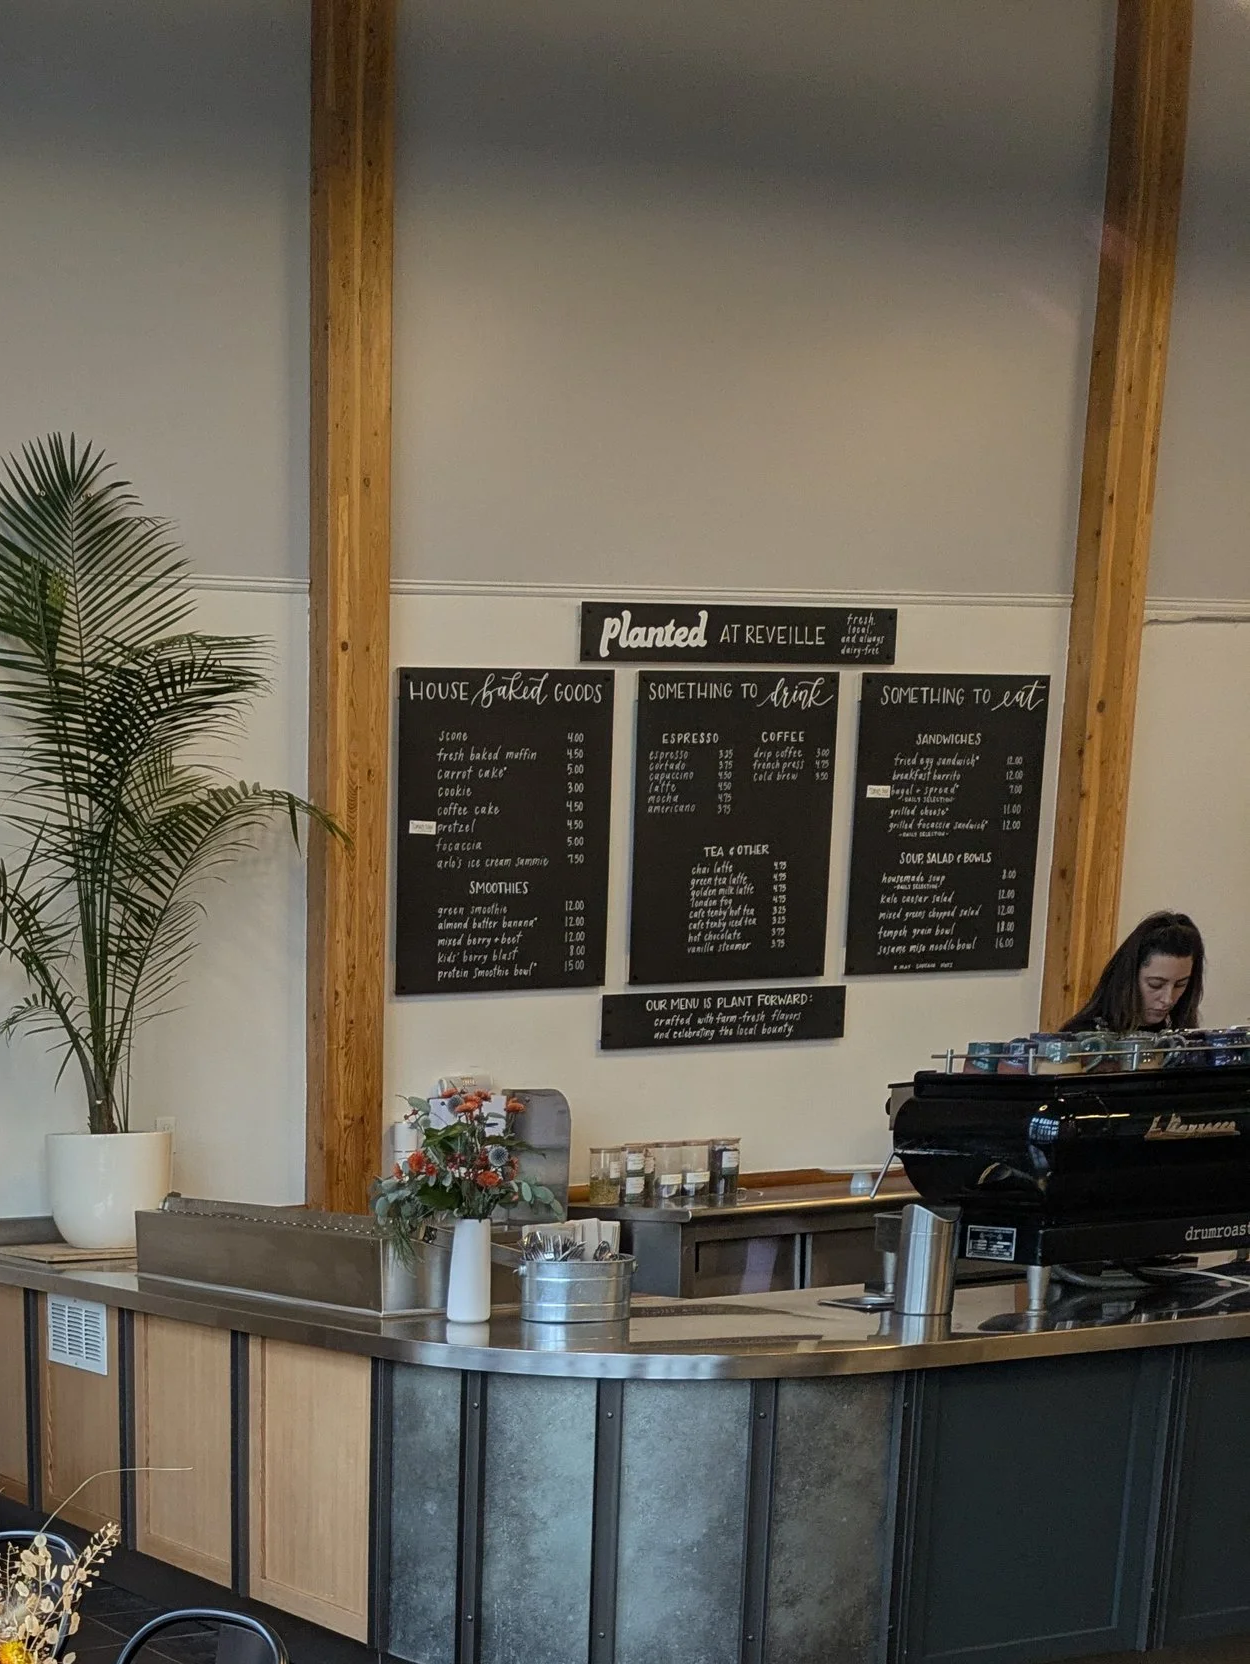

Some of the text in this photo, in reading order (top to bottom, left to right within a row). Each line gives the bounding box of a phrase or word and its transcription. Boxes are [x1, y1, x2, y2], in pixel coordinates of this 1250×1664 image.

[599, 610, 826, 657] Planted AT REVEILLE
[841, 634, 885, 645] and always
[840, 644, 880, 658] dairy-free
[409, 672, 602, 708] HOUSE baked GOODS
[649, 678, 833, 710] SOMETHING TO drink
[881, 680, 1046, 711] SOMETHING TO eat
[439, 731, 584, 742] scone 4.00
[662, 733, 719, 744] ESPRESSO
[762, 731, 805, 743] COFFEE
[916, 733, 982, 745] SANDWICHES
[437, 746, 583, 762] fresh baked muffin 4.50
[649, 751, 689, 761] espresso
[754, 747, 803, 761] drip coffee
[894, 752, 917, 766] fried
[920, 756, 934, 770] egg
[437, 767, 473, 780] carrot
[567, 764, 584, 774] 5.00
[649, 761, 686, 771] cortado
[753, 760, 805, 772] french press
[753, 772, 799, 781] cold brew
[892, 770, 1023, 781] breakfast burrito 12.00
[438, 783, 584, 797] cookie 3.00
[649, 782, 677, 793] latte
[891, 784, 913, 799] bagel
[648, 794, 679, 803] mocha
[437, 801, 583, 816] coffee cake 4.50
[648, 804, 696, 813] americano
[889, 804, 915, 818] grilled
[1003, 804, 1021, 814] 11.00
[437, 819, 475, 833] pretzel
[567, 819, 583, 829] 4.50
[888, 821, 915, 834] grilled
[917, 821, 950, 829] focaccia
[1002, 820, 1020, 830] 12.00
[436, 837, 584, 852] focaccia 5.00
[704, 845, 769, 857] TEA OTHER
[468, 859, 480, 868] ice
[486, 858, 511, 867] cream
[515, 857, 549, 867] sammie
[567, 854, 584, 864] 7.50
[927, 853, 954, 864] SALAD
[964, 852, 992, 863] BOWLS
[692, 862, 733, 875] chai latte
[690, 874, 748, 890] green tea latte
[882, 872, 945, 885] housemade soup
[469, 881, 529, 894] SMOOTHIES
[690, 885, 755, 900] golden milk latte
[691, 896, 732, 909] london fog
[902, 895, 929, 904] caesar
[932, 892, 954, 903] salad
[438, 900, 584, 920] green smoothie 12.00
[730, 906, 742, 916] hot
[743, 905, 755, 916] tea
[879, 908, 900, 921] mixed
[904, 908, 925, 920] greens
[929, 907, 954, 919] chopped
[960, 905, 982, 916] salad
[438, 917, 468, 930] almond
[473, 917, 498, 929] butter
[565, 917, 584, 926] 12.00
[729, 916, 745, 928] iced
[745, 915, 757, 925] tea
[688, 930, 741, 942] hot chocolate
[877, 923, 955, 939] tempeh grain bowl
[438, 932, 585, 948] mixed berry beet 12.00
[877, 937, 1014, 955] sesame miso noodle bowl 16.00
[687, 942, 751, 954] vanilla steamer
[463, 950, 488, 964] berry
[493, 947, 519, 961] blast
[437, 966, 468, 981] protein
[473, 964, 509, 977] smoothie
[646, 994, 813, 1011] OUR MENU IS PLANT FORWARD:
[654, 1010, 801, 1026] crafted with farm-fresh flavors
[654, 1030, 671, 1040] and
[673, 1028, 715, 1040] celebrating
[719, 1026, 733, 1036] the
[736, 1025, 757, 1036] local
